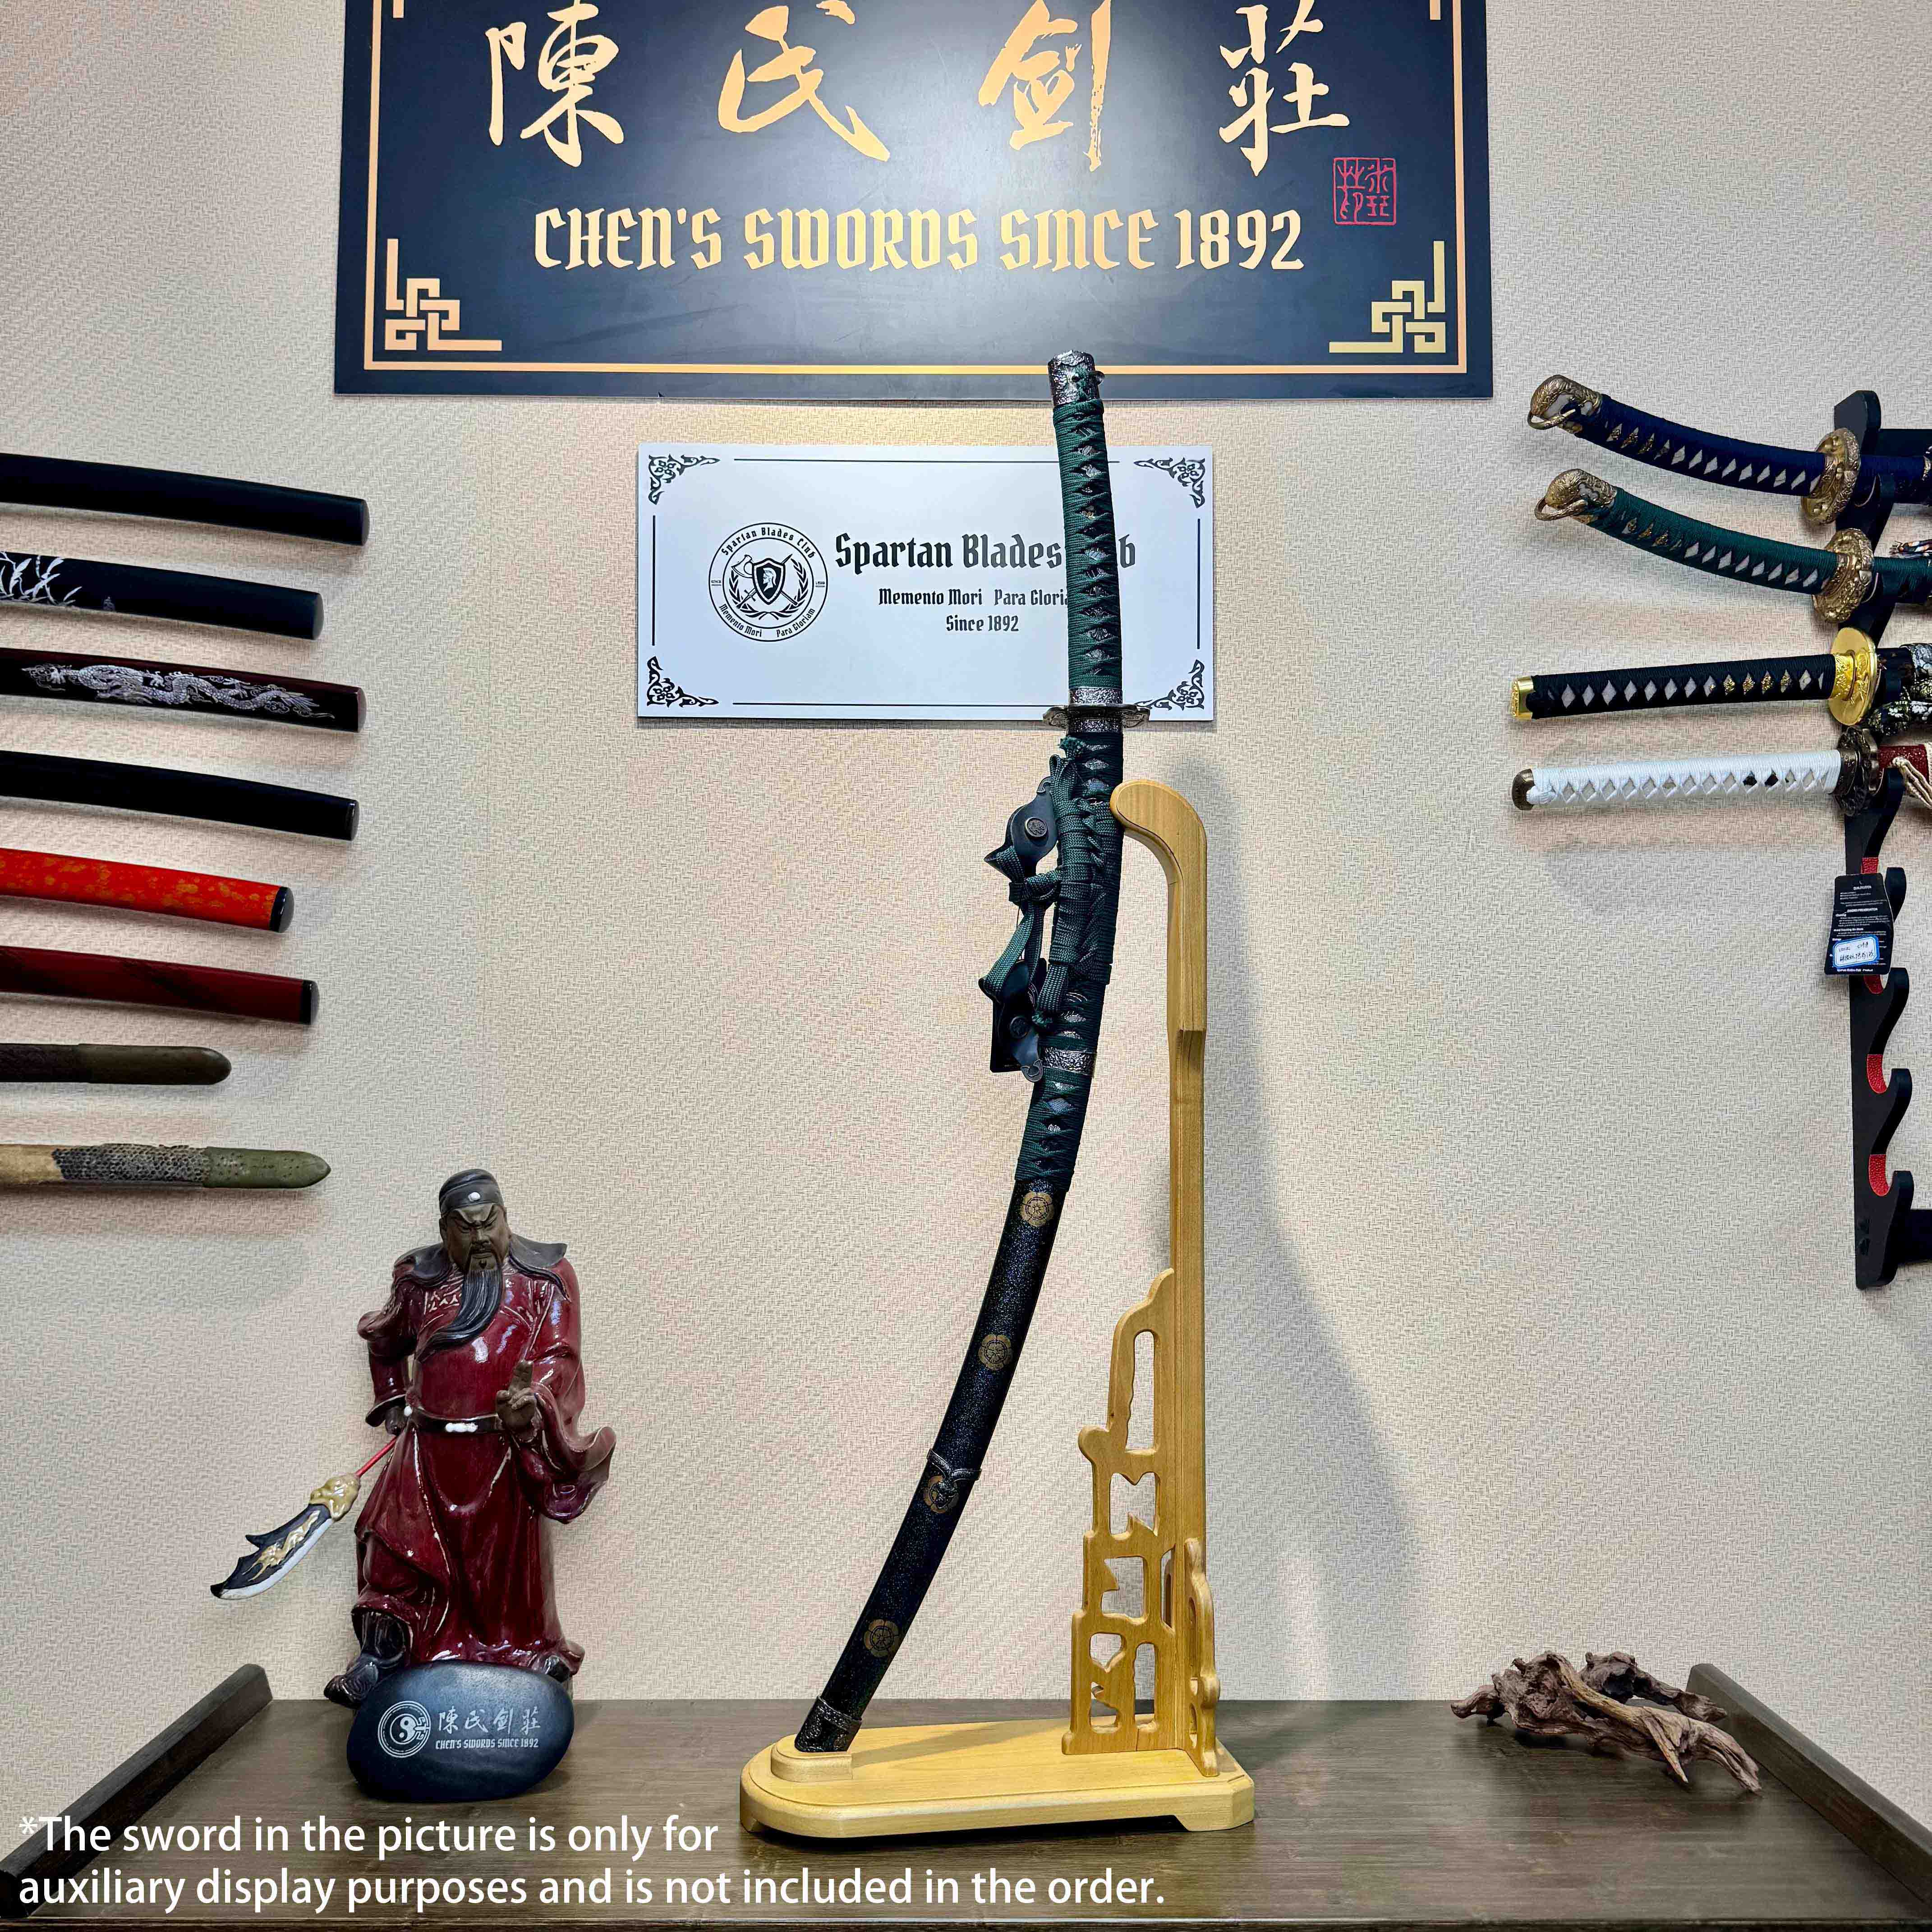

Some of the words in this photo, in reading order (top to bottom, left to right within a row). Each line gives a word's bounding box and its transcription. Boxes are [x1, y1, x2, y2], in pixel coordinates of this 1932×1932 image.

[535, 208, 722, 270] CHEN'S
[743, 208, 978, 271] SWORDS
[999, 209, 1158, 271] SINCE
[1175, 209, 1304, 270] 1892
[722, 530, 757, 556] Spartan
[761, 527, 794, 541] Blades
[797, 538, 816, 558] Club
[835, 533, 953, 575] Spartan
[961, 534, 1062, 569] Blades
[879, 588, 944, 606] Memento
[947, 588, 983, 606] Mori
[994, 589, 1026, 606] Para
[719, 603, 744, 630] Memento
[744, 626, 762, 637] Mori
[776, 628, 793, 637] Para
[792, 608, 816, 629] Gloriam
[946, 614, 984, 631] Since
[988, 615, 1019, 632] 1892
[435, 1739, 462, 1750] CHEN'S
[463, 1739, 496, 1749] SWORDS
[497, 1738, 519, 1748] SINCE
[520, 1738, 539, 1748] 1892
